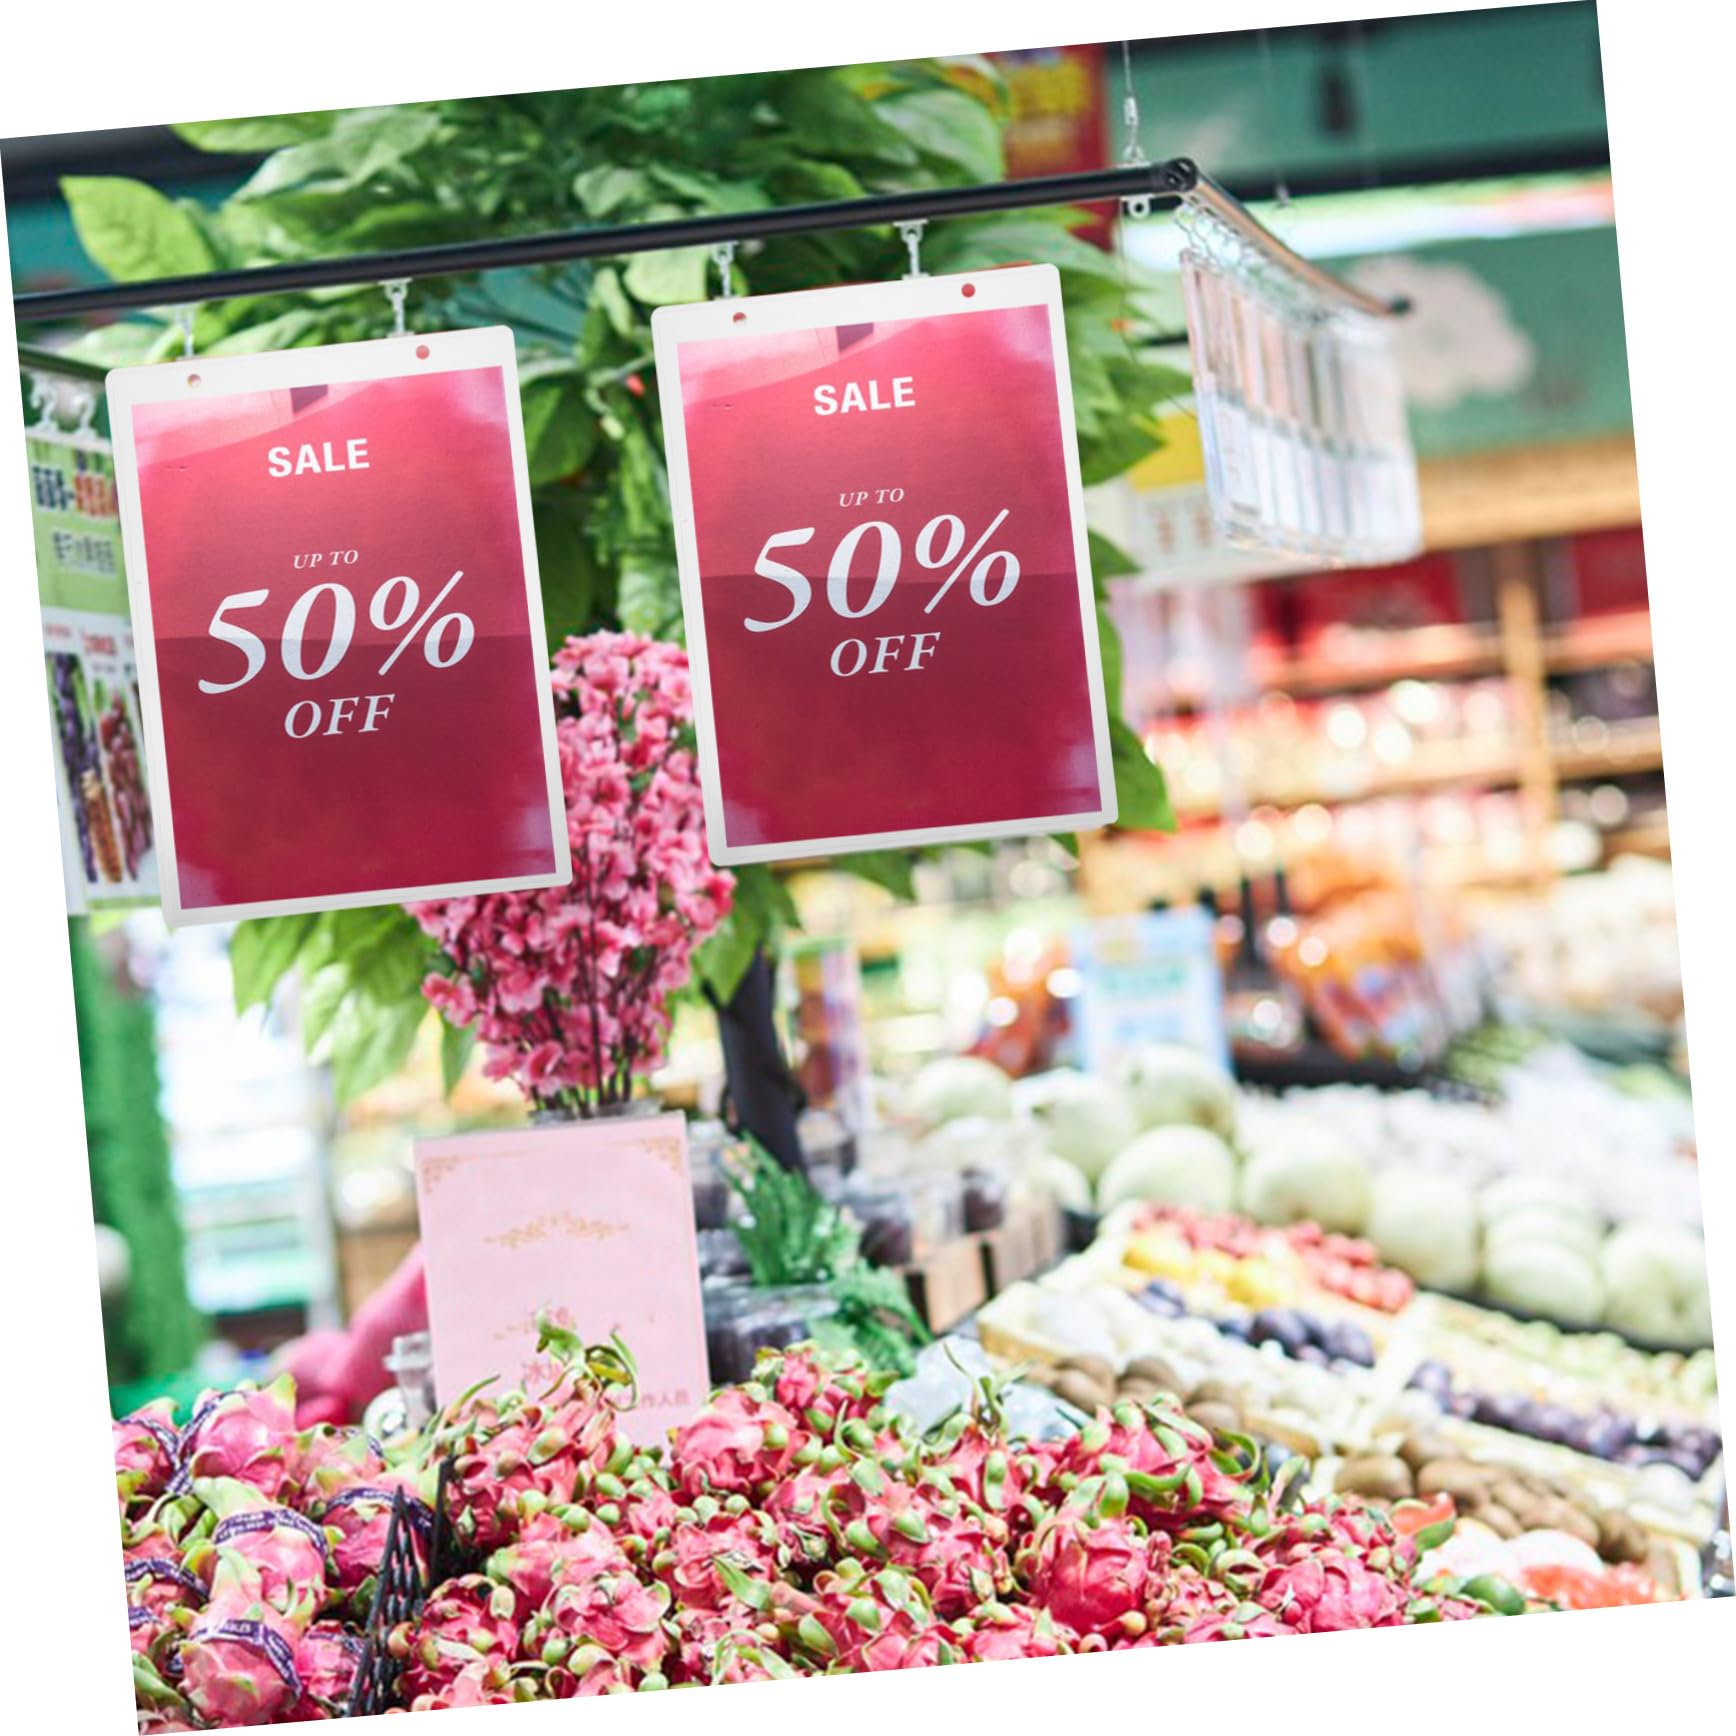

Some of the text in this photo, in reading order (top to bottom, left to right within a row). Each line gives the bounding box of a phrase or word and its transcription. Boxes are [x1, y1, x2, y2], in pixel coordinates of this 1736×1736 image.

[813, 376, 916, 416] SALE
[267, 437, 370, 478] SALE
[839, 487, 905, 508] UP TO
[293, 549, 359, 570] UP TO
[743, 508, 1021, 633] 50%
[198, 570, 475, 695] 50%
[829, 631, 942, 677] OFF
[284, 693, 396, 739] OFF
